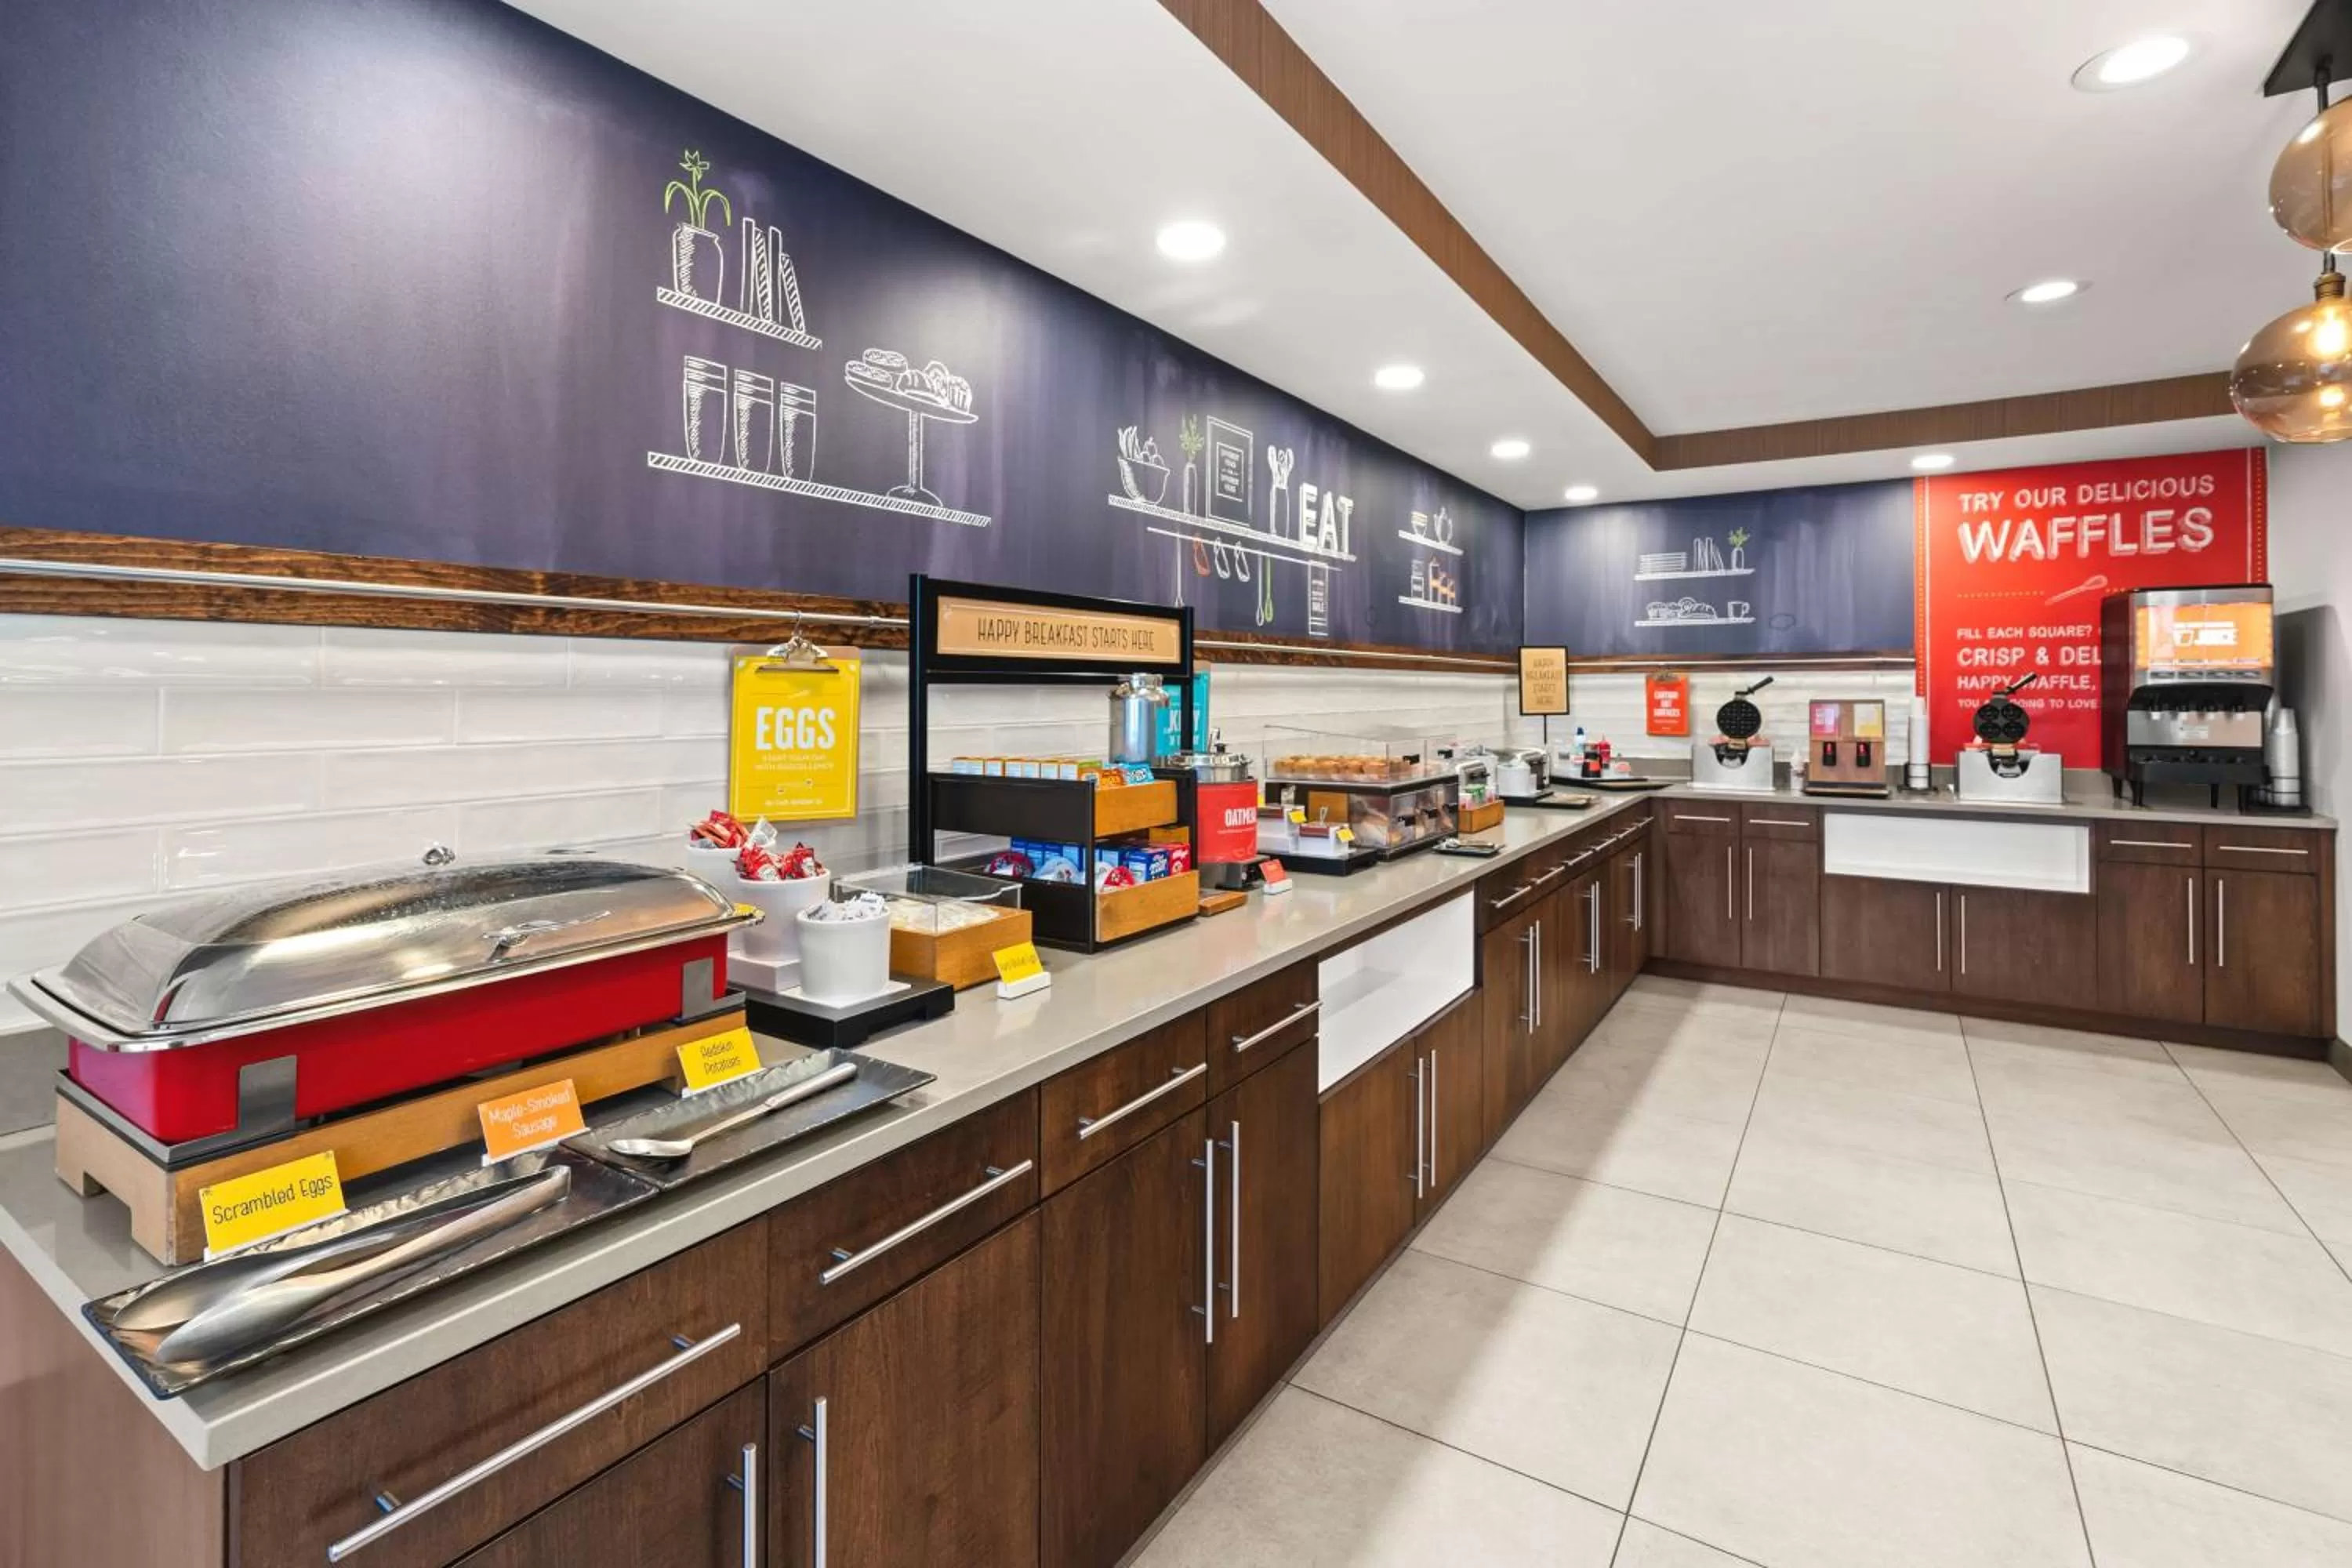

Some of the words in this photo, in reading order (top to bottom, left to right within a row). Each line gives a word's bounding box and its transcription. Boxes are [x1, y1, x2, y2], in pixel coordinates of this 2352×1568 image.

[1958, 491, 2004, 513] TRY
[2014, 487, 2066, 508] OUR
[2078, 474, 2215, 506] DELICIOUS
[1299, 482, 1354, 554] EAT
[1958, 506, 2214, 564] WAFFLES
[978, 616, 1019, 644] HAPPY
[1025, 620, 1088, 648] BREAKFAST
[1092, 626, 1128, 652] STARTS
[1131, 630, 1155, 652] HERE
[1957, 627, 1982, 640] FILL
[1987, 626, 2023, 640] EACH
[2029, 625, 2092, 638] SQUARE?
[1957, 646, 2025, 666] CRISP
[2035, 646, 2049, 666] &
[1957, 674, 2013, 690] HAPPY
[2050, 699, 2064, 710] TO
[2068, 699, 2097, 710] LOVE
[756, 706, 836, 750] EGGS
[212, 1184, 296, 1225] Scrambled
[299, 1175, 333, 1199] Eggs
